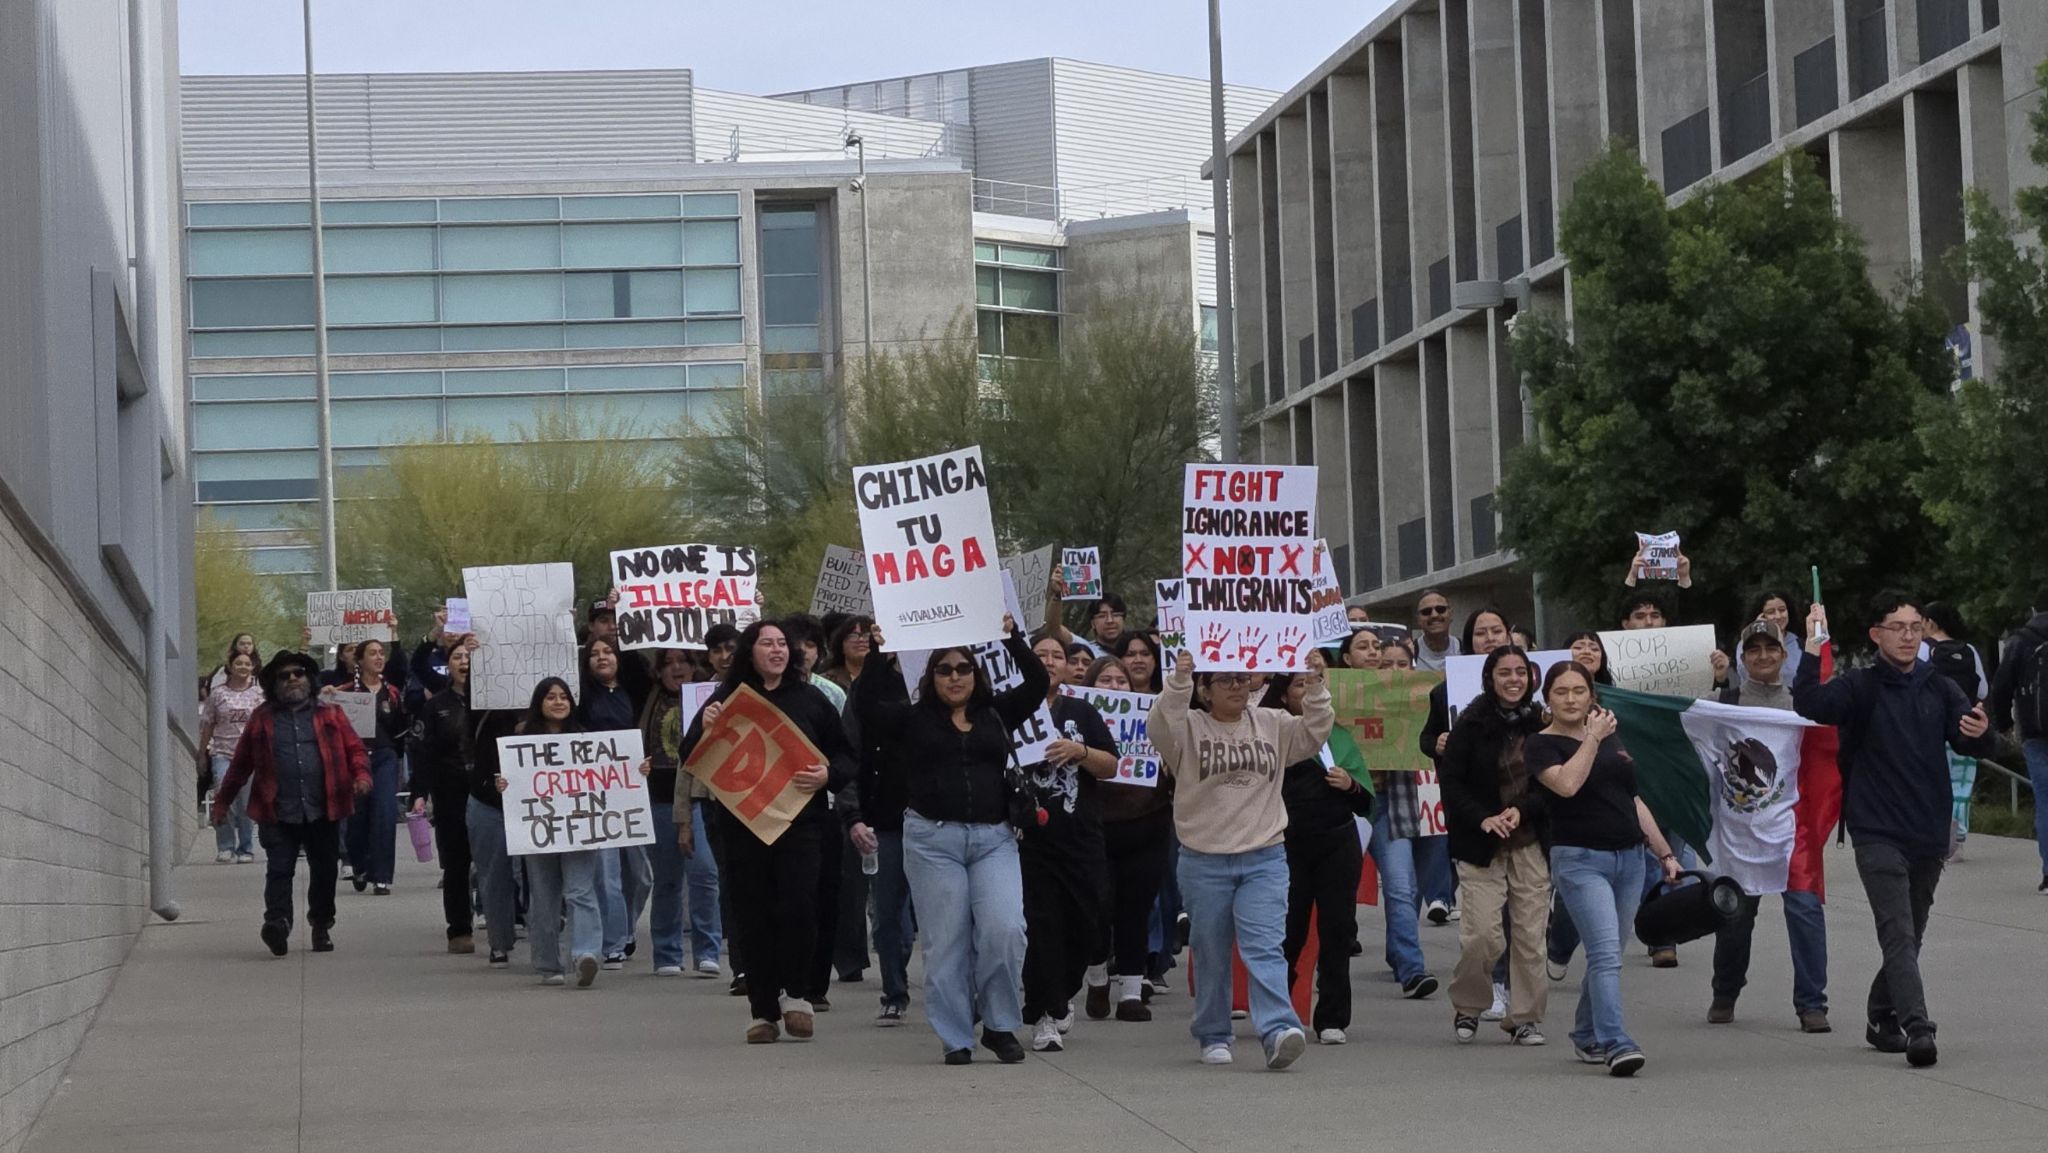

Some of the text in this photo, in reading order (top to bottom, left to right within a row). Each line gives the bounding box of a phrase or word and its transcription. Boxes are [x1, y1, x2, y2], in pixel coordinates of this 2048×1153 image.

[858, 455, 986, 510] CHINGA
[1195, 470, 1284, 503] FIGHT
[896, 513, 942, 546] TU
[1184, 507, 1308, 537] IGNORANCE
[617, 543, 756, 581] NO ONE IS
[826, 556, 864, 576] BUILT
[872, 536, 986, 585] MAGA
[1064, 551, 1097, 566] VIVA
[1213, 545, 1274, 576] NOT
[820, 571, 851, 591] FEED
[1187, 577, 1312, 615] IMMIGRANTS
[309, 589, 388, 612] IMMIGRANTS
[489, 589, 537, 617] OUR
[816, 587, 866, 611] PROTECT
[343, 608, 391, 625] AMERICA
[618, 609, 655, 645] ON
[1610, 634, 1667, 661] YOUR
[505, 738, 630, 767] THE REAL
[1199, 739, 1277, 783] BRONCO
[533, 762, 641, 797] CRIMNAL
[521, 790, 606, 821] IS IN
[530, 808, 648, 848] OFFICE
